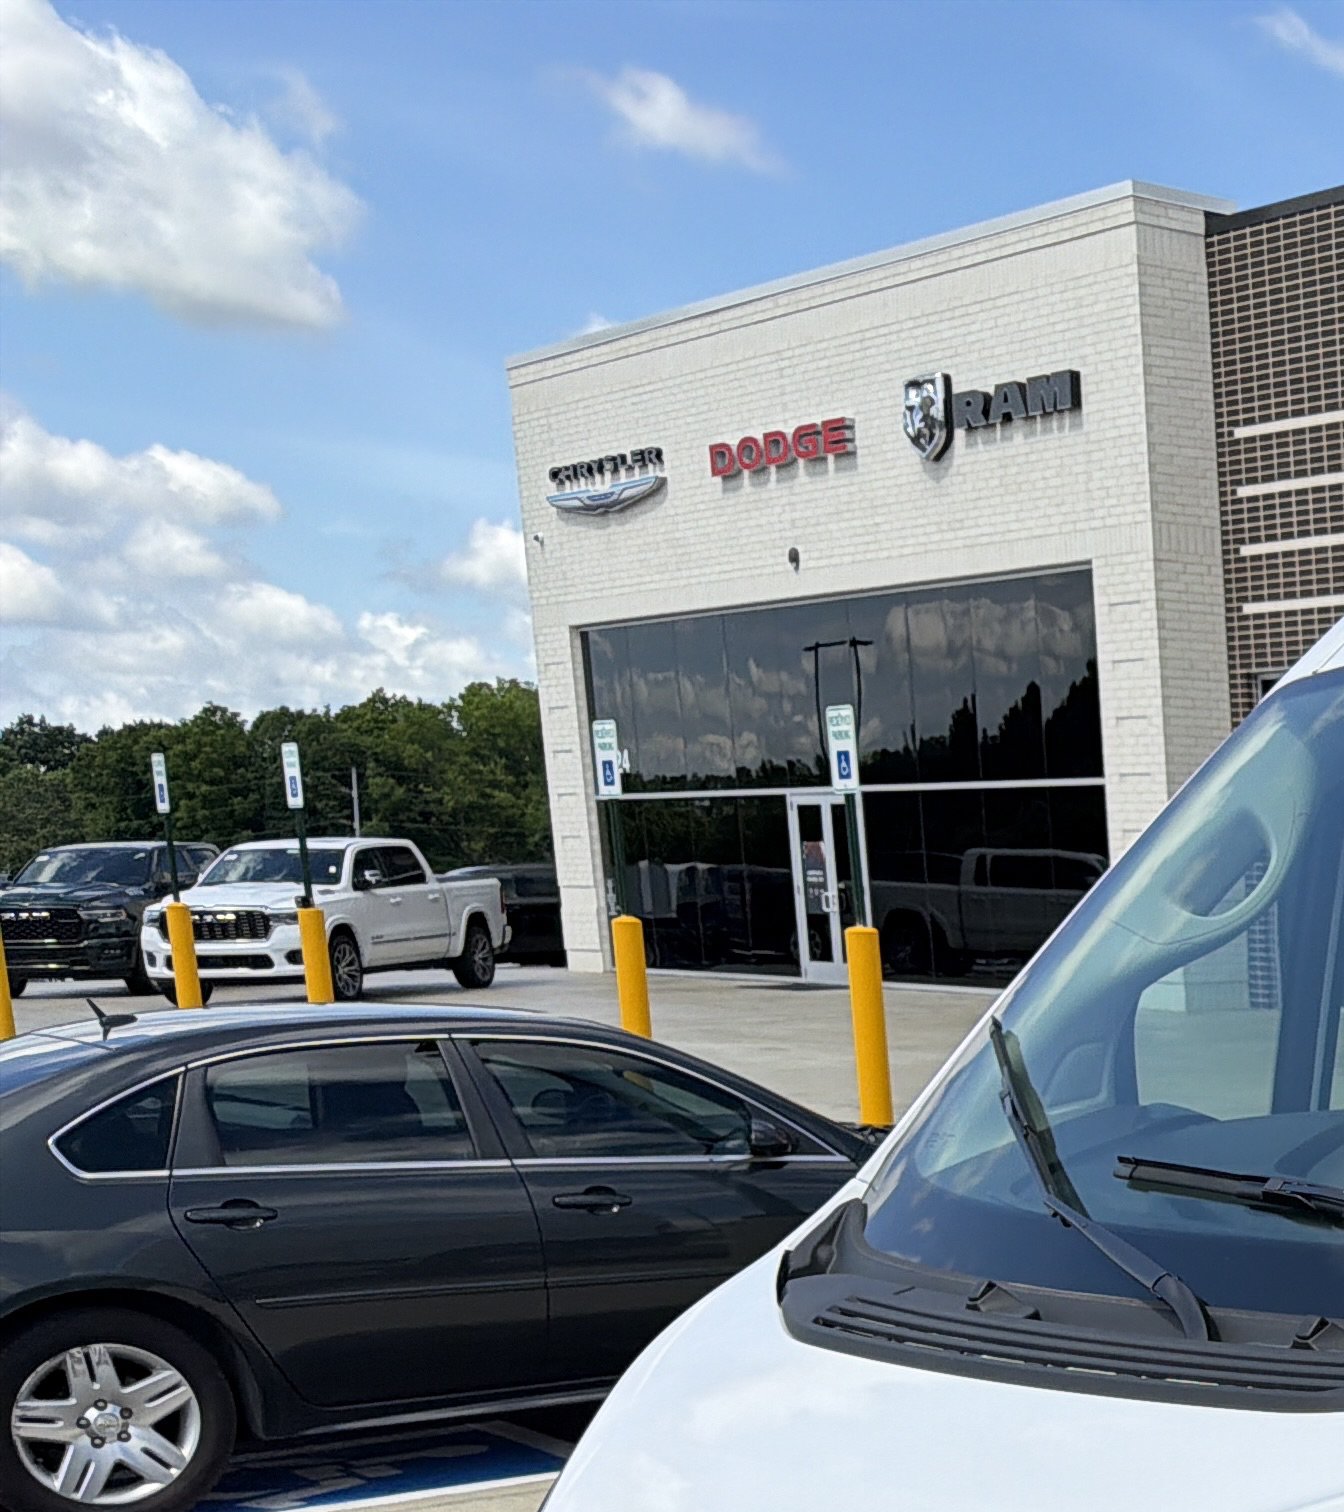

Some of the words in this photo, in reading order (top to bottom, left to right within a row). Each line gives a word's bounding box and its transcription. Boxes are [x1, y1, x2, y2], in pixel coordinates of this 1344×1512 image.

[952, 370, 1082, 428] RAM
[549, 447, 664, 484] CHRYSLER
[709, 417, 855, 477] DODGE
